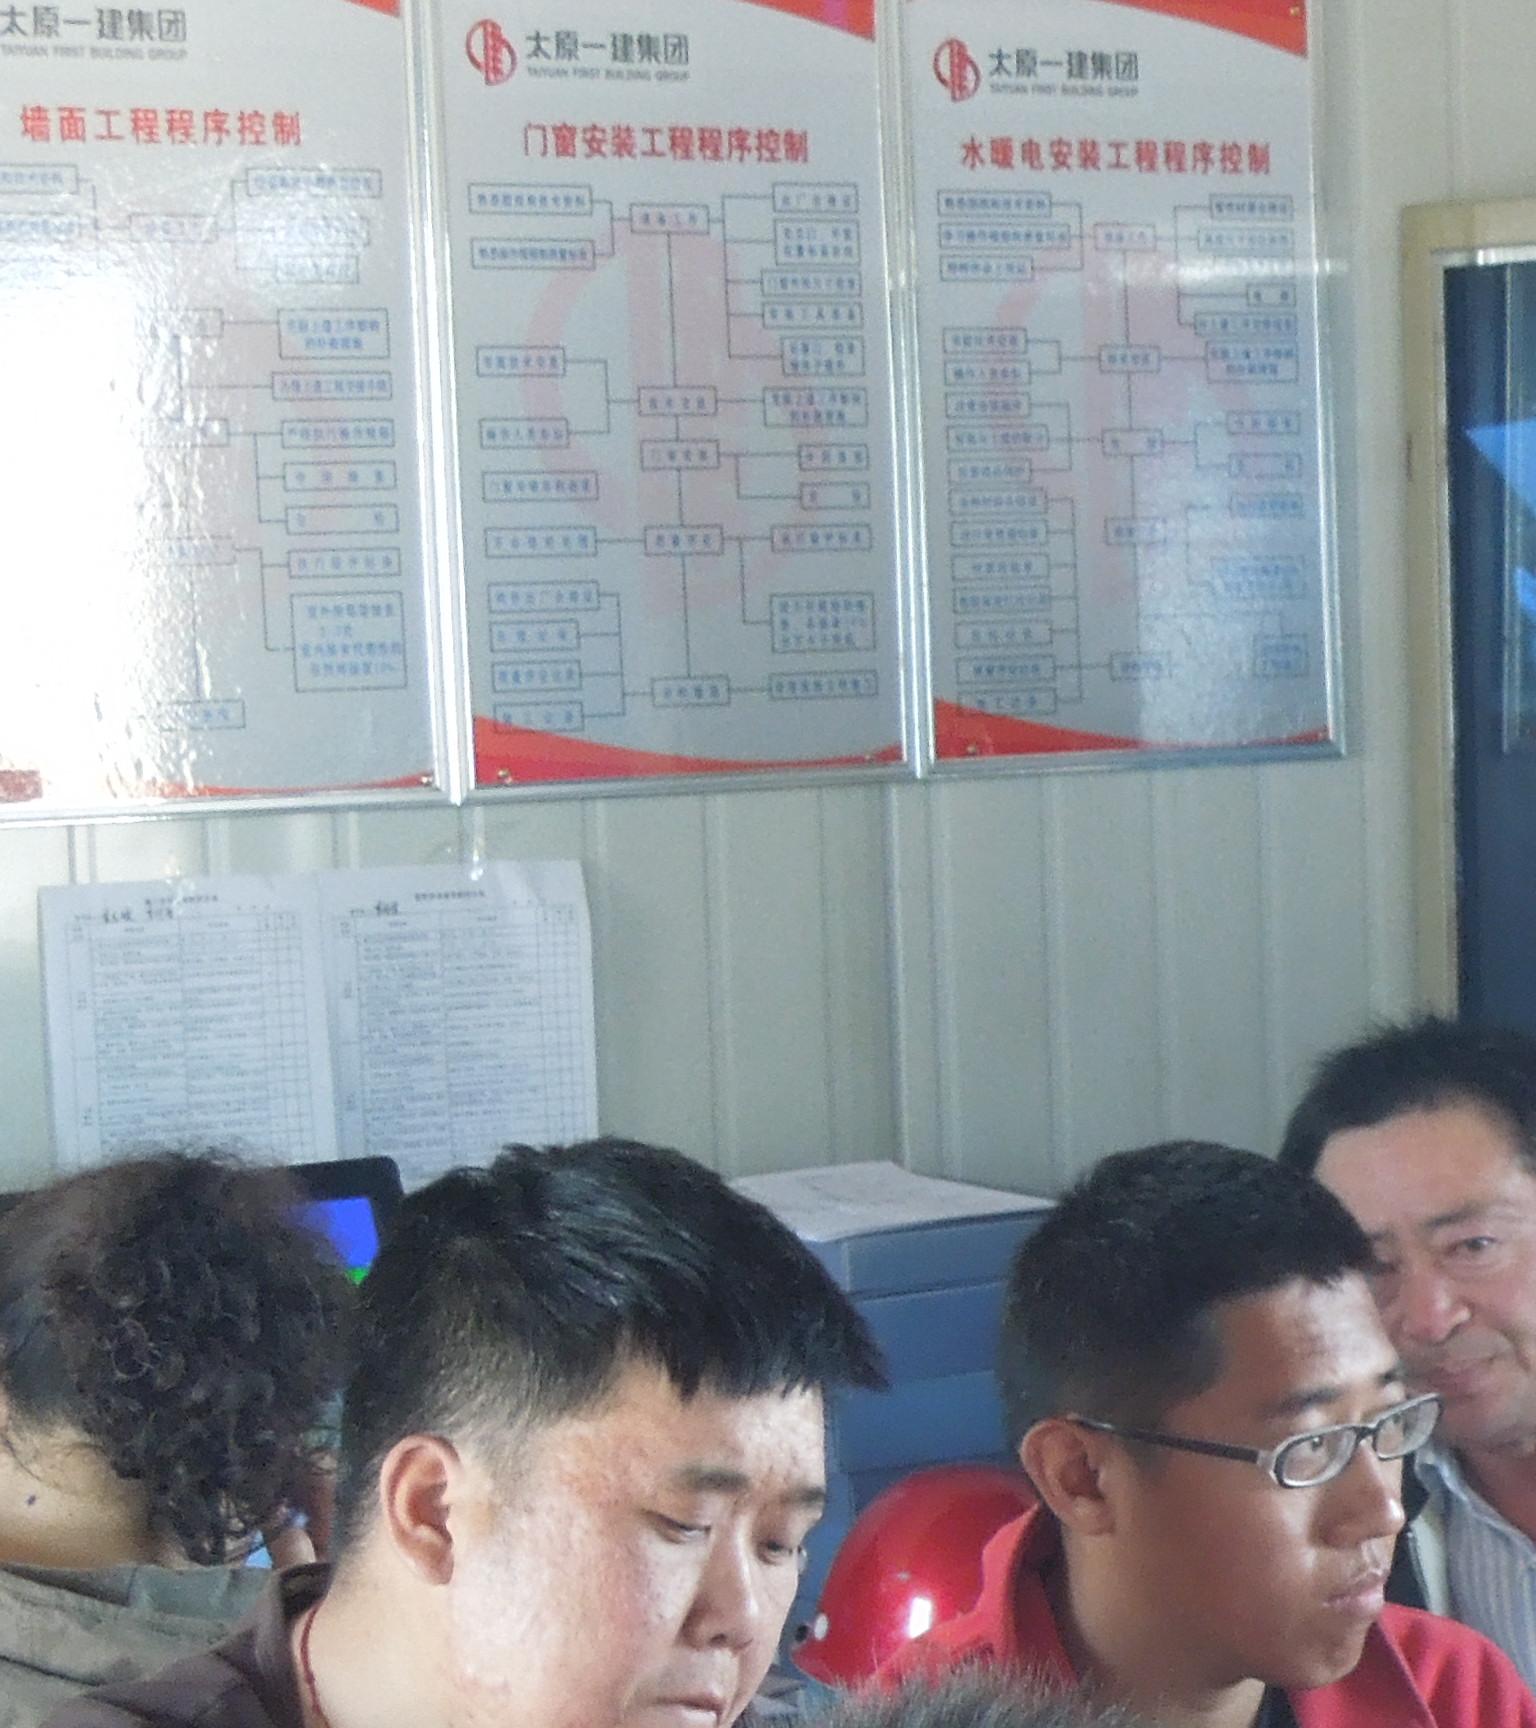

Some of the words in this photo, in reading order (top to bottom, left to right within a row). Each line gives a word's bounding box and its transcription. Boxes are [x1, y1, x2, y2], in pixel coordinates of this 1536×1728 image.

[0, 5, 187, 42] 太原一建集团
[526, 31, 690, 65] 太原一建集团
[989, 49, 1139, 81] 太原一建集团
[20, 105, 302, 146] 墙面工程程序控制
[523, 122, 809, 163] 门窗安装工程程序控制
[961, 137, 1270, 174] 水暖电安装工程程序控制
